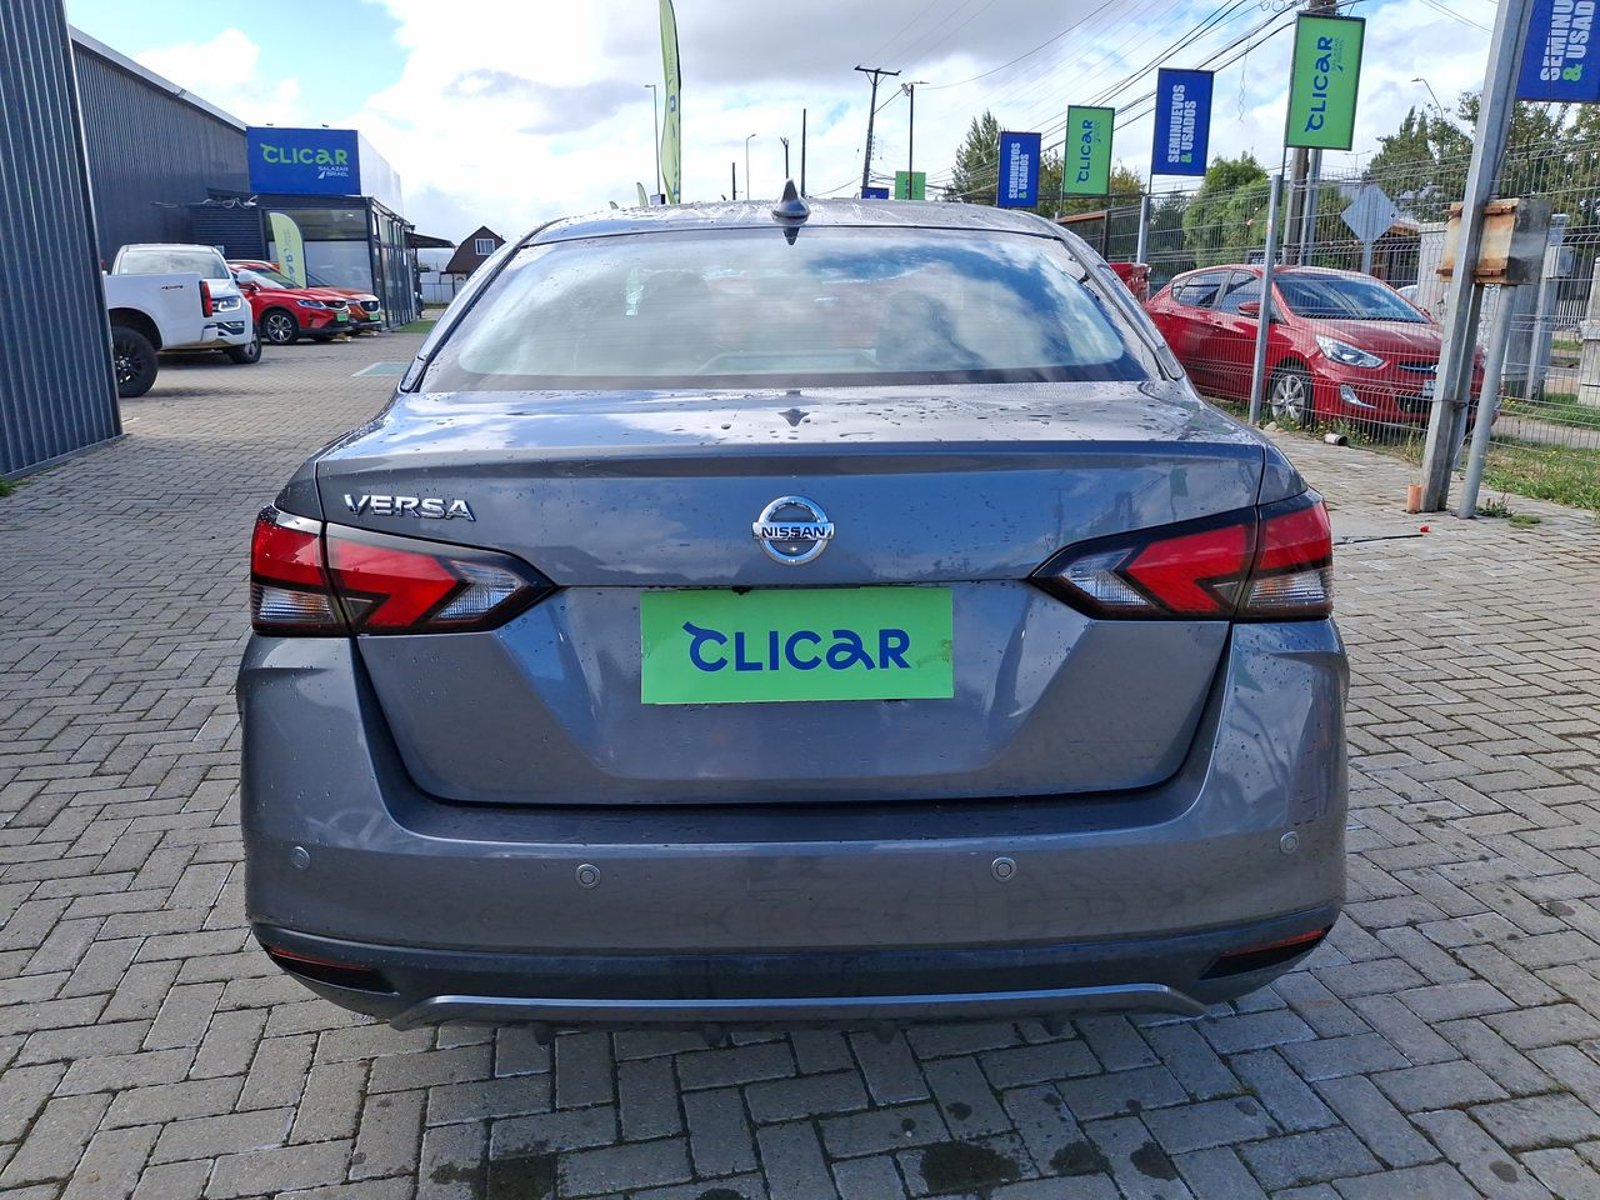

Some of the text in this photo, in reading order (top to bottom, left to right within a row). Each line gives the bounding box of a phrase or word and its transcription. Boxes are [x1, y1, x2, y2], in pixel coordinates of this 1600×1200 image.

[1562, 63, 1583, 82] &
[1167, 84, 1186, 163] SEMINUEVOS
[1180, 100, 1197, 151] USADOS
[1008, 142, 1021, 200] SEMINUEVOS
[1018, 153, 1030, 190] USADOS
[344, 494, 476, 522] VERSA
[761, 526, 826, 538] NISSAN
